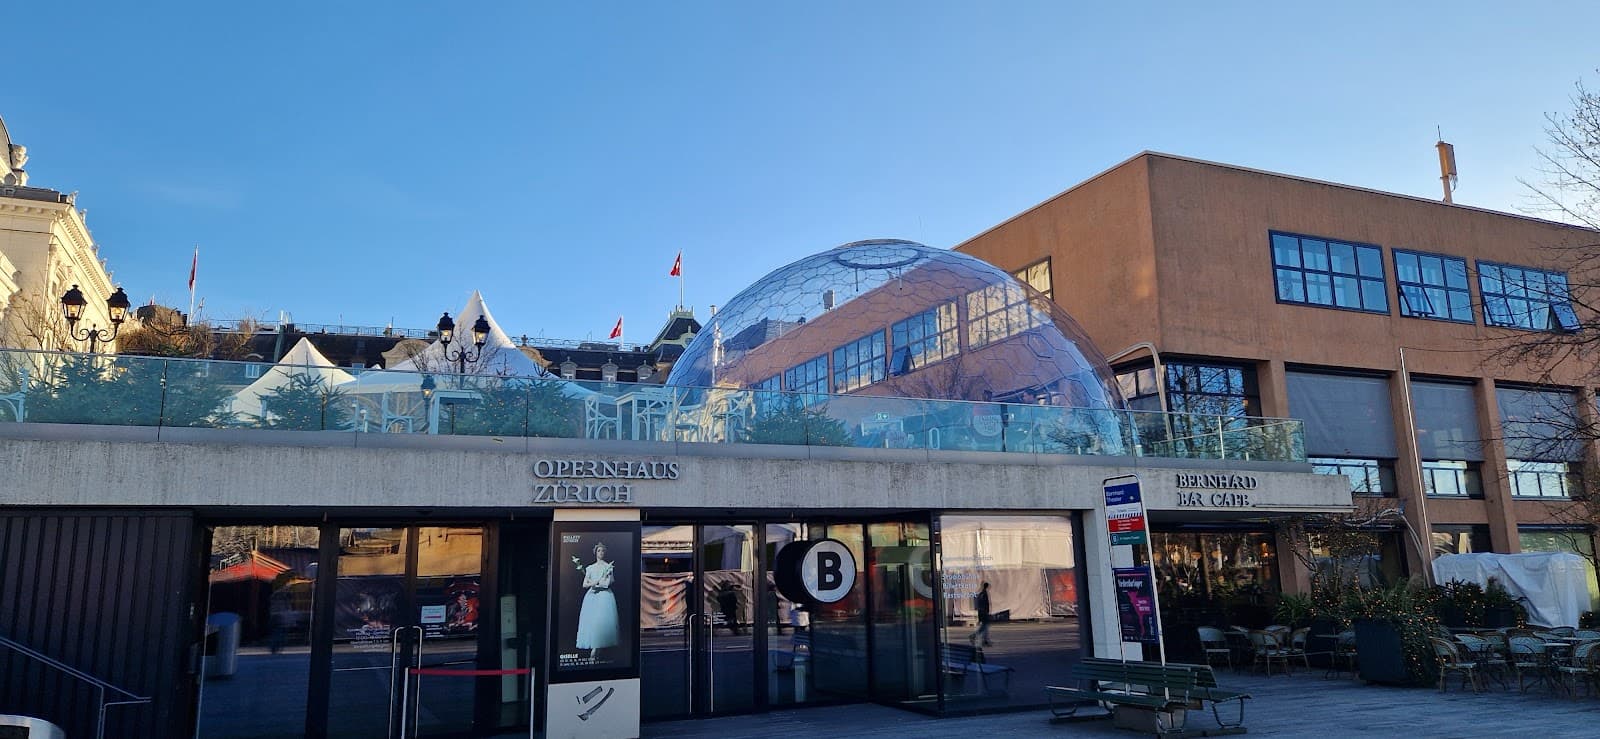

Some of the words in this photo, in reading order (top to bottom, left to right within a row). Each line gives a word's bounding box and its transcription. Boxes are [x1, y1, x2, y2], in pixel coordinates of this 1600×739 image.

[533, 459, 680, 480] OPERNHAUS
[533, 480, 632, 503] ZÜRICH
[1177, 473, 1258, 490] BERNHARD
[1178, 492, 1205, 507] BAR
[817, 551, 843, 591] B
